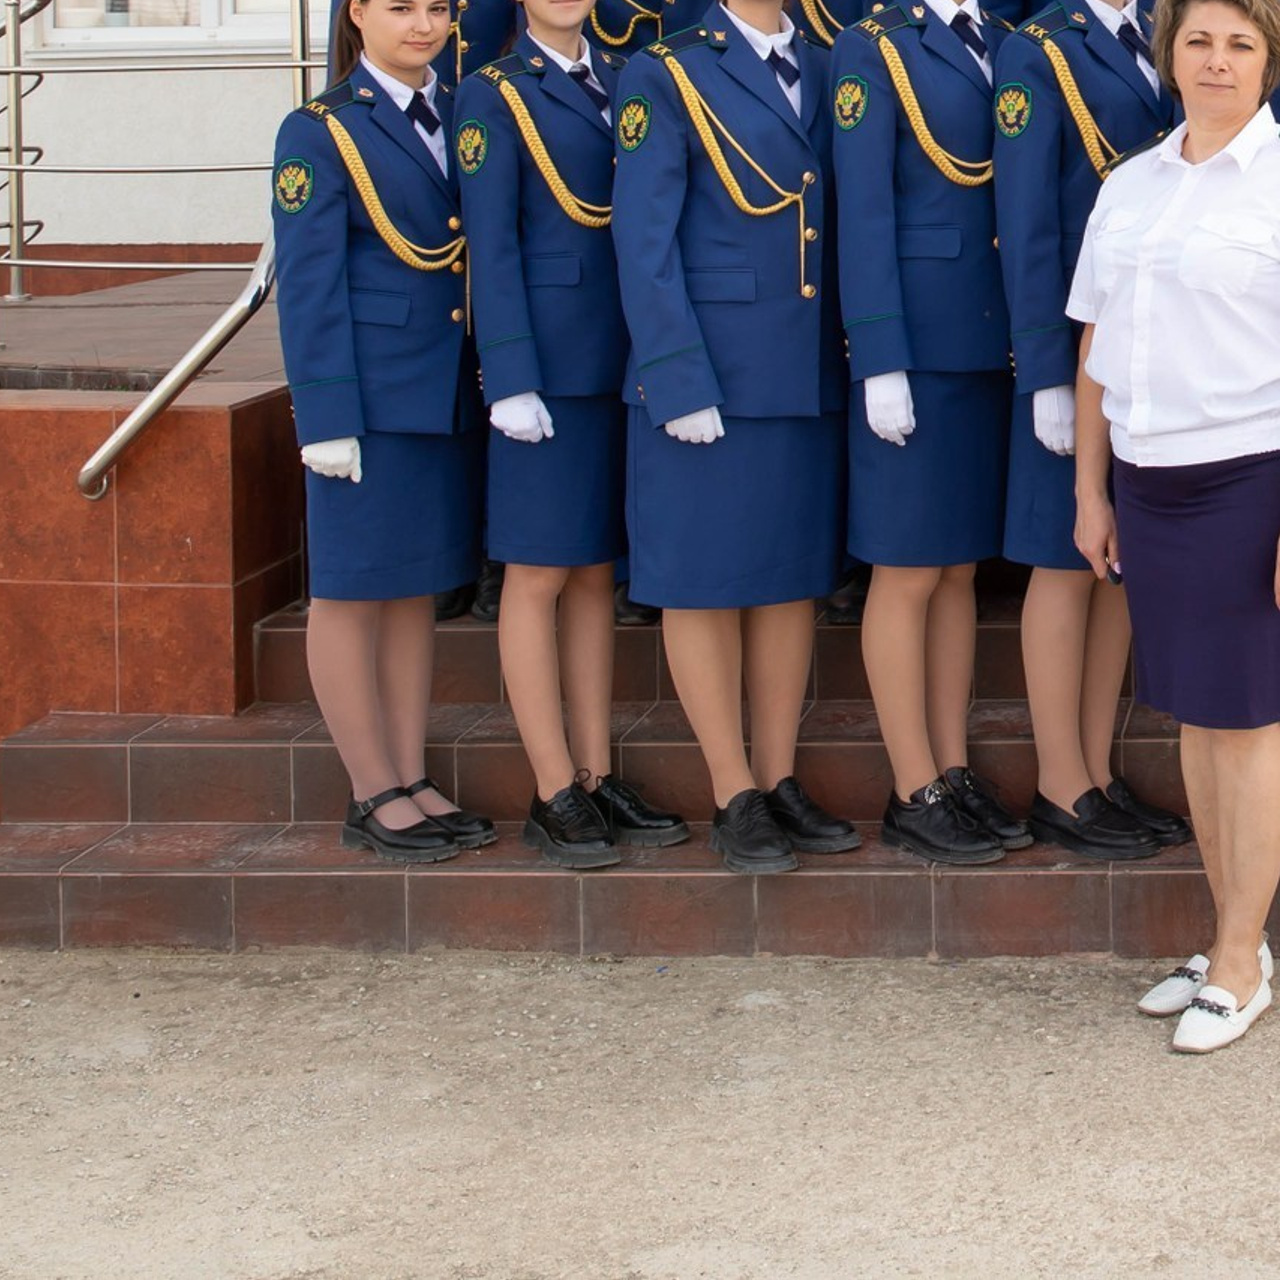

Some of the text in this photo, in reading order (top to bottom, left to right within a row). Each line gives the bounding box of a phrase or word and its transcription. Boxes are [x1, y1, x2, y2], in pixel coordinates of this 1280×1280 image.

[860, 19, 884, 35] КК
[1025, 24, 1049, 39] КК
[649, 43, 672, 55] КК
[481, 66, 505, 80] КК
[306, 101, 330, 115] КК
